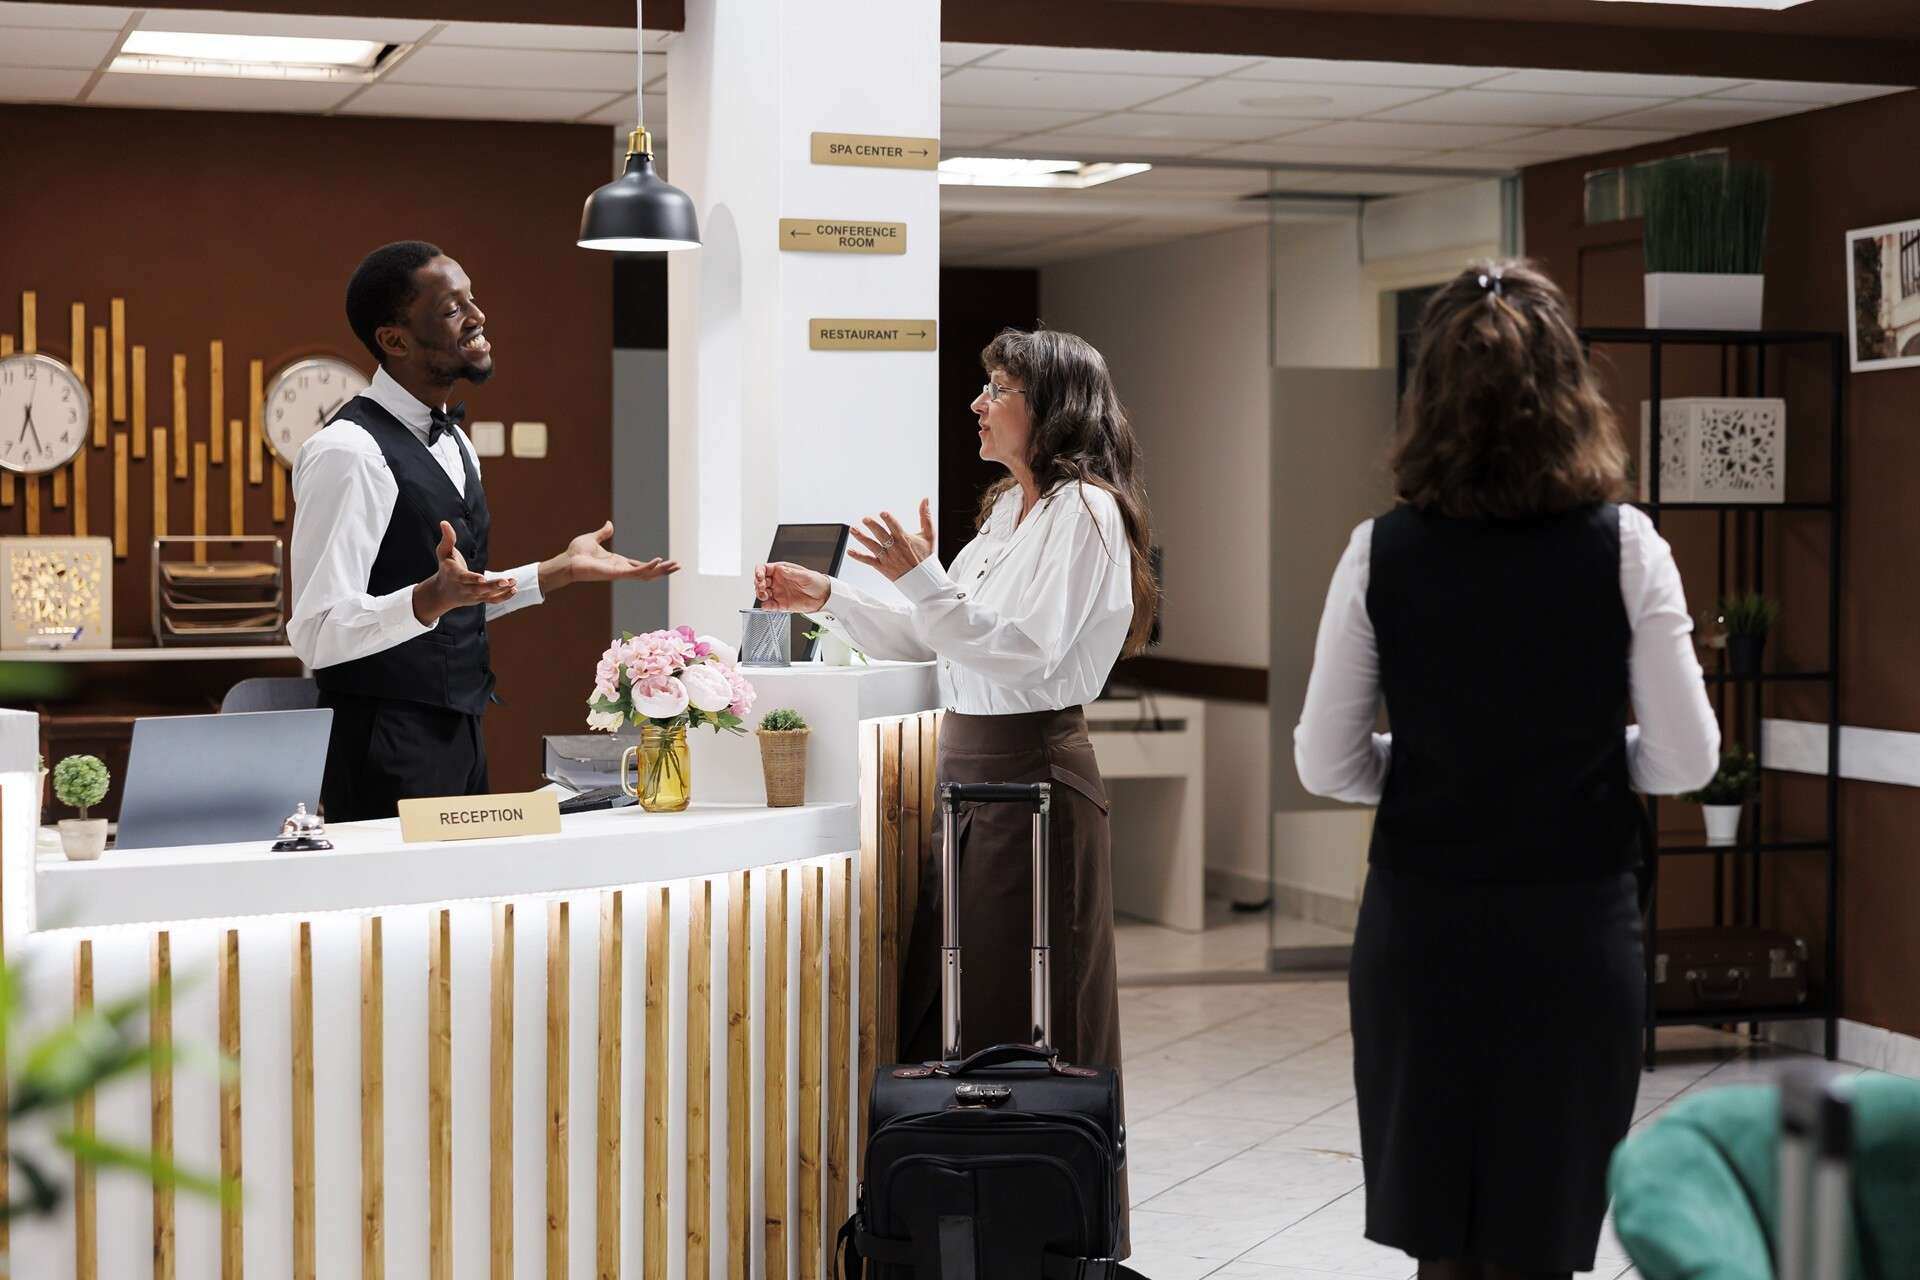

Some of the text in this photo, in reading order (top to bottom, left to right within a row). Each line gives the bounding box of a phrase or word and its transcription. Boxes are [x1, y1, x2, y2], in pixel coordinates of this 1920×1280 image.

[829, 144, 903, 157] SPA CENTER
[816, 225, 897, 238] CONFERENCE
[839, 237, 875, 248] ROOM
[820, 329, 899, 340] RESTAURANT
[4, 371, 14, 386] 11
[24, 363, 37, 380] 12
[62, 386, 71, 402] 2
[284, 389, 296, 403] 10
[68, 407, 77, 424] 3
[60, 431, 69, 443] 4
[6, 441, 13, 455] 7
[23, 449, 32, 464] 6
[440, 808, 523, 825] RECEPTION
